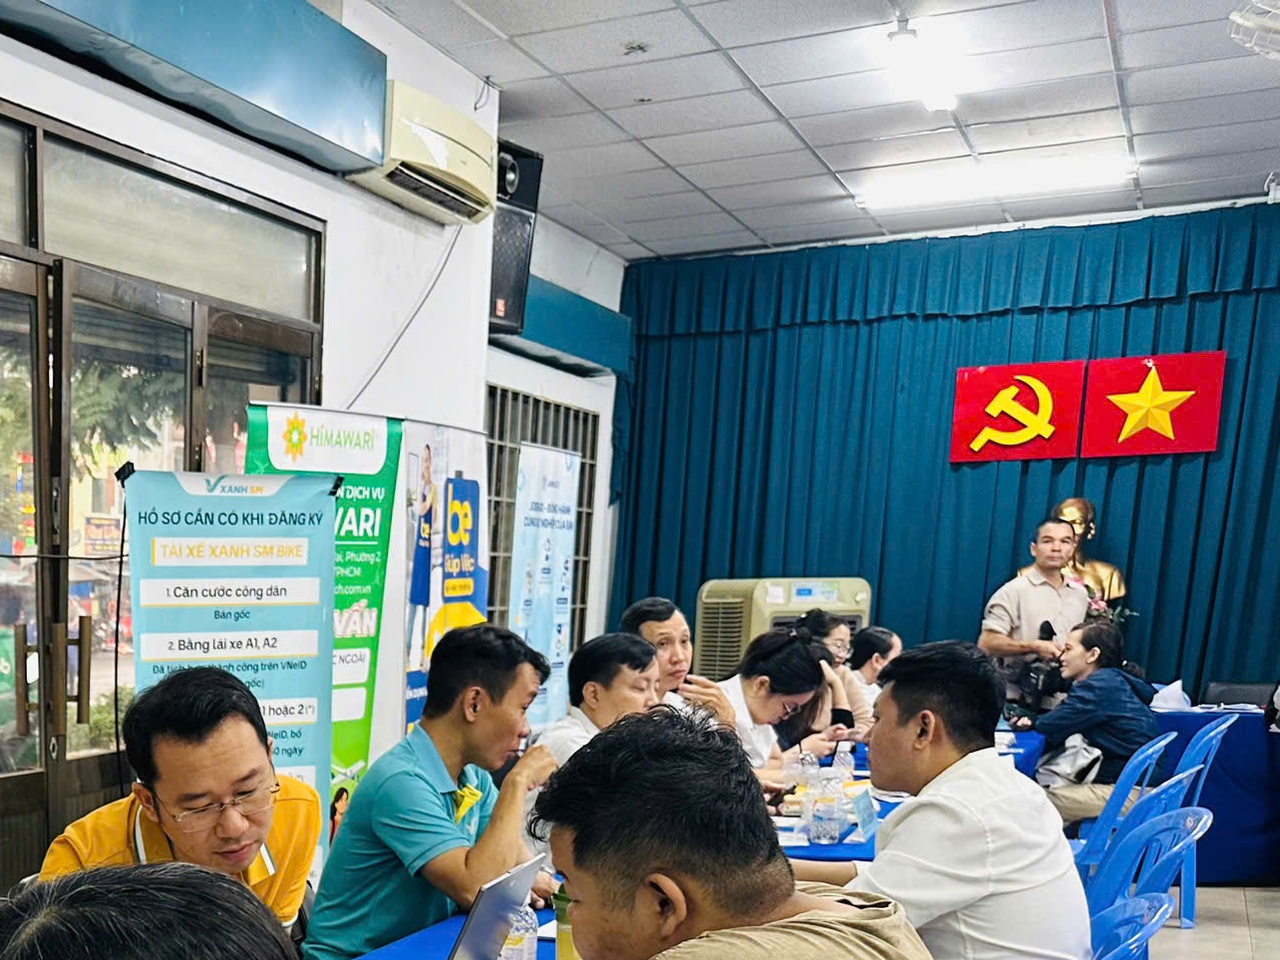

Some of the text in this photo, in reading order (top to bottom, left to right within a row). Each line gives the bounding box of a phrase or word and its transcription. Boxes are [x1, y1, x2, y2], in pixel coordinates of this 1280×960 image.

[220, 485, 264, 495] XANH SM
[346, 486, 370, 502] DỊCH
[161, 509, 182, 526] SƠ
[242, 512, 264, 526] KHI
[268, 509, 306, 526] ĐĂNG
[447, 483, 472, 546] be
[209, 544, 250, 559] XANH
[254, 544, 274, 559] SM
[277, 544, 303, 559] BIKE
[173, 585, 199, 598] Căn
[201, 586, 233, 598] cước
[235, 586, 263, 600] công
[266, 585, 287, 598] dân
[229, 640, 243, 650] xe
[263, 637, 278, 649] A2
[269, 704, 295, 718] hoặc
